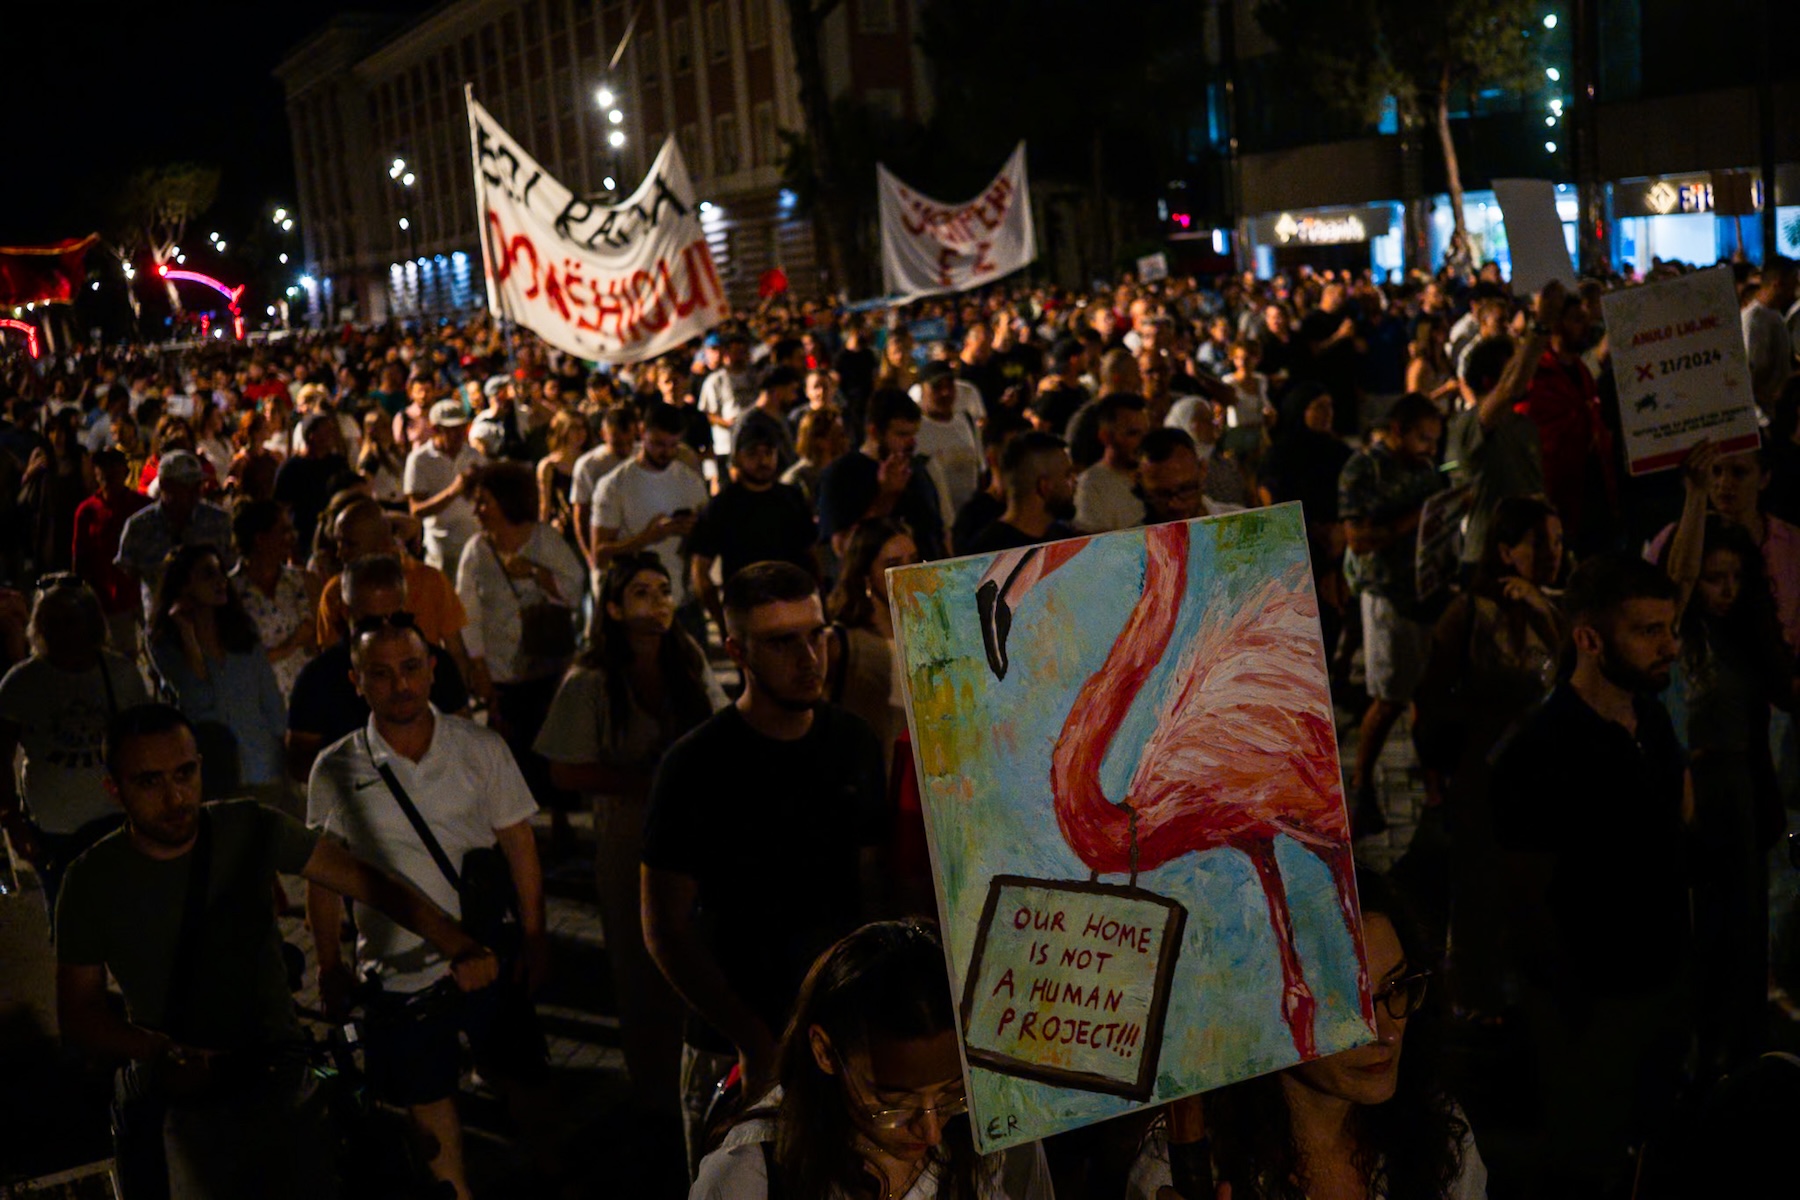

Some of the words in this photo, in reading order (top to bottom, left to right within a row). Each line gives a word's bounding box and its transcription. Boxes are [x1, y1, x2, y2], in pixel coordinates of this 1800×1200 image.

[1660, 350, 1722, 375] 21/2024
[1014, 907, 1066, 933] OUR
[1082, 913, 1152, 954] HOME
[1029, 940, 1049, 965] IS
[1060, 948, 1114, 974] NOT
[992, 968, 1015, 998] A
[1029, 978, 1123, 1013] HUMAN
[997, 1007, 1141, 1058] PROJECT!!!
